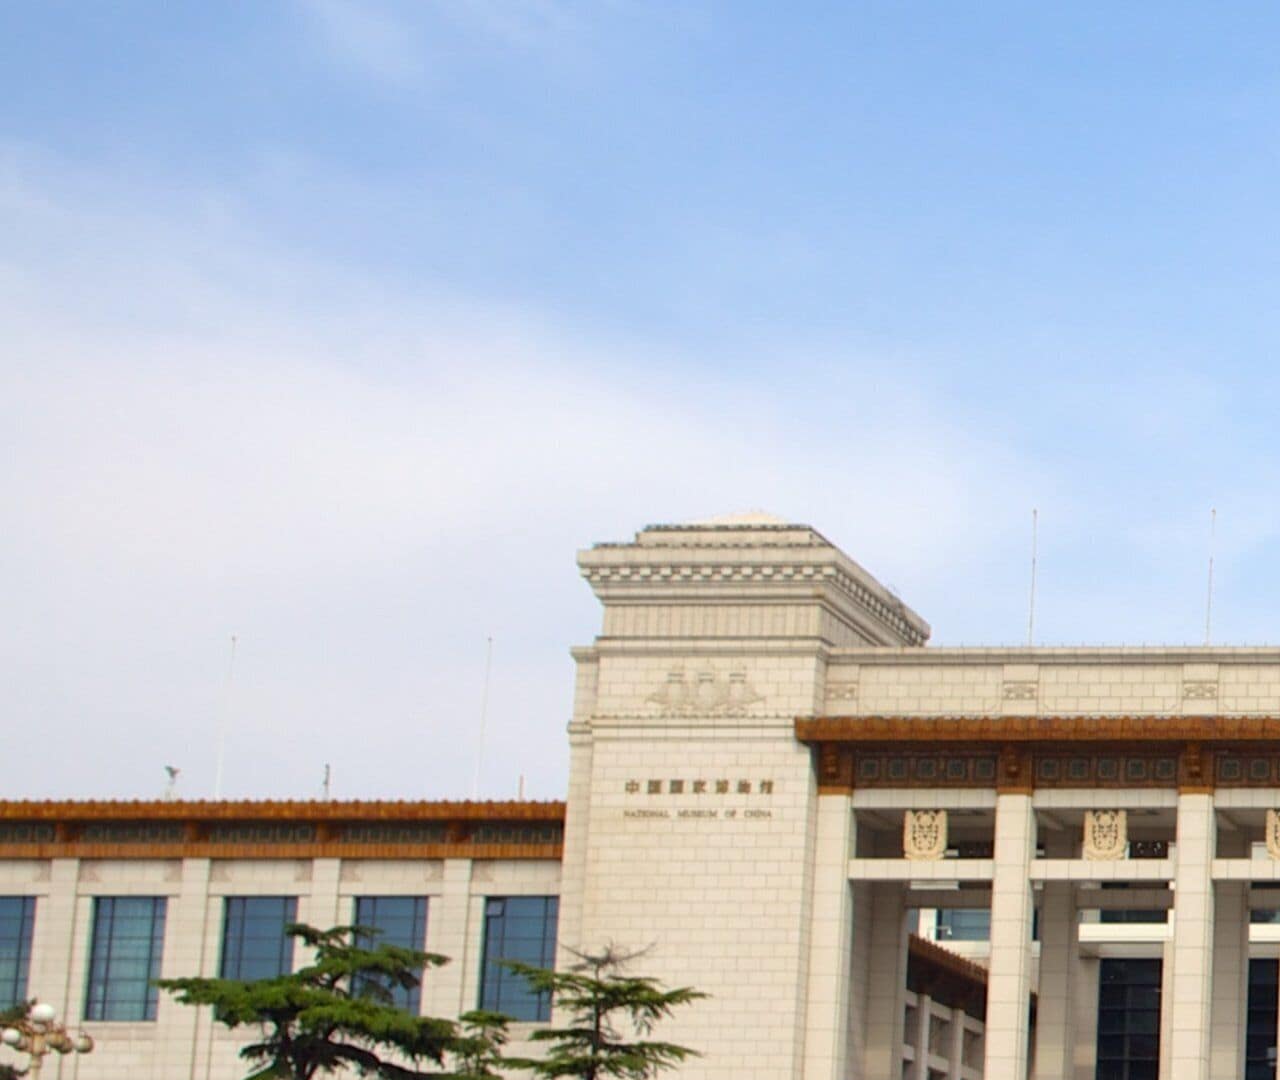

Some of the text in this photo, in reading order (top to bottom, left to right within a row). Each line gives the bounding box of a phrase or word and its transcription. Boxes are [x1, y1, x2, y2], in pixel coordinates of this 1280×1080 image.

[623, 809, 772, 818] NATIONAL MUSEUM OF CHINA
